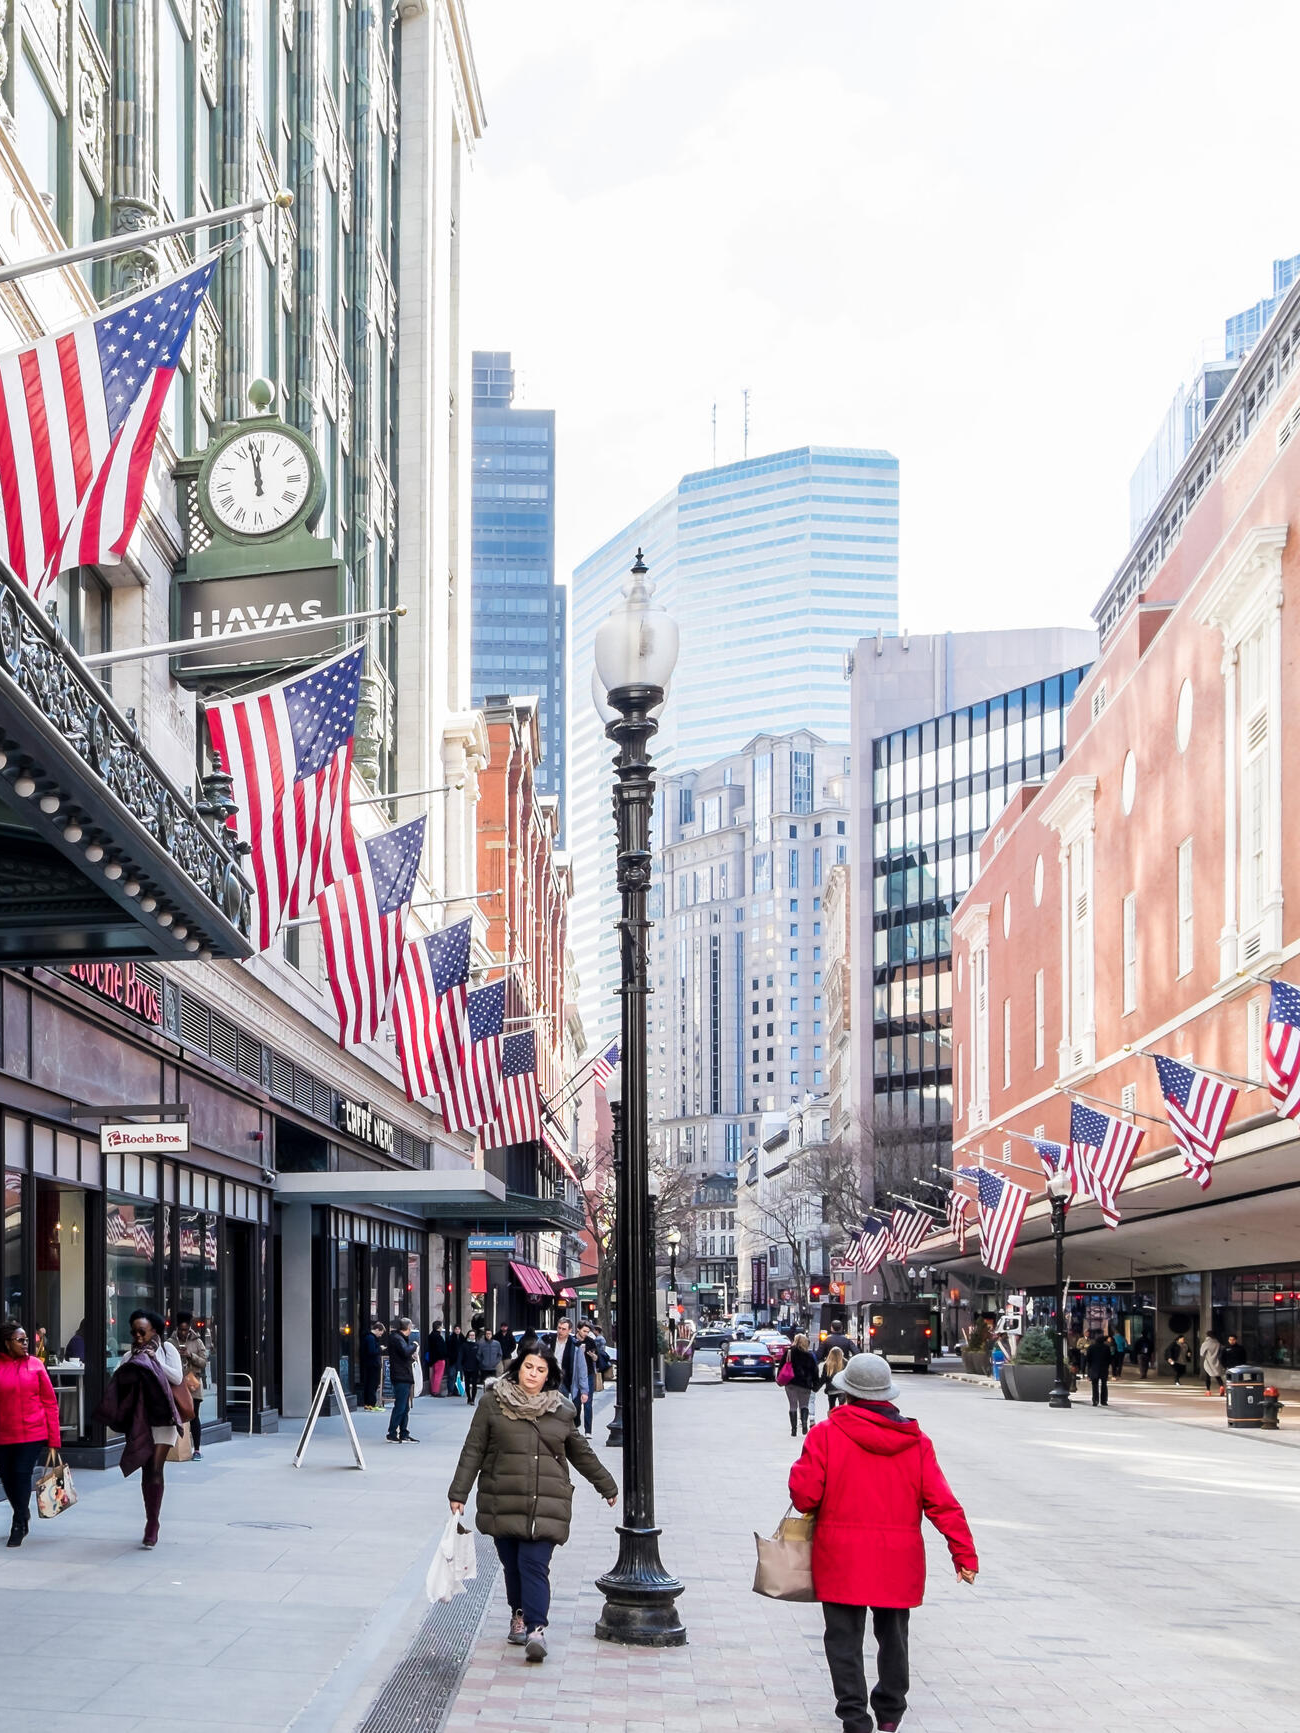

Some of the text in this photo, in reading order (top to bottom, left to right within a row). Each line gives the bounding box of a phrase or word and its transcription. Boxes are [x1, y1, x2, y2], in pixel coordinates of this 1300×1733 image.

[193, 599, 322, 639] HAVAS
[122, 1133, 182, 1144] Roche Bros.
[373, 1117, 394, 1153] NERO
[831, 1258, 855, 1267] CVS
